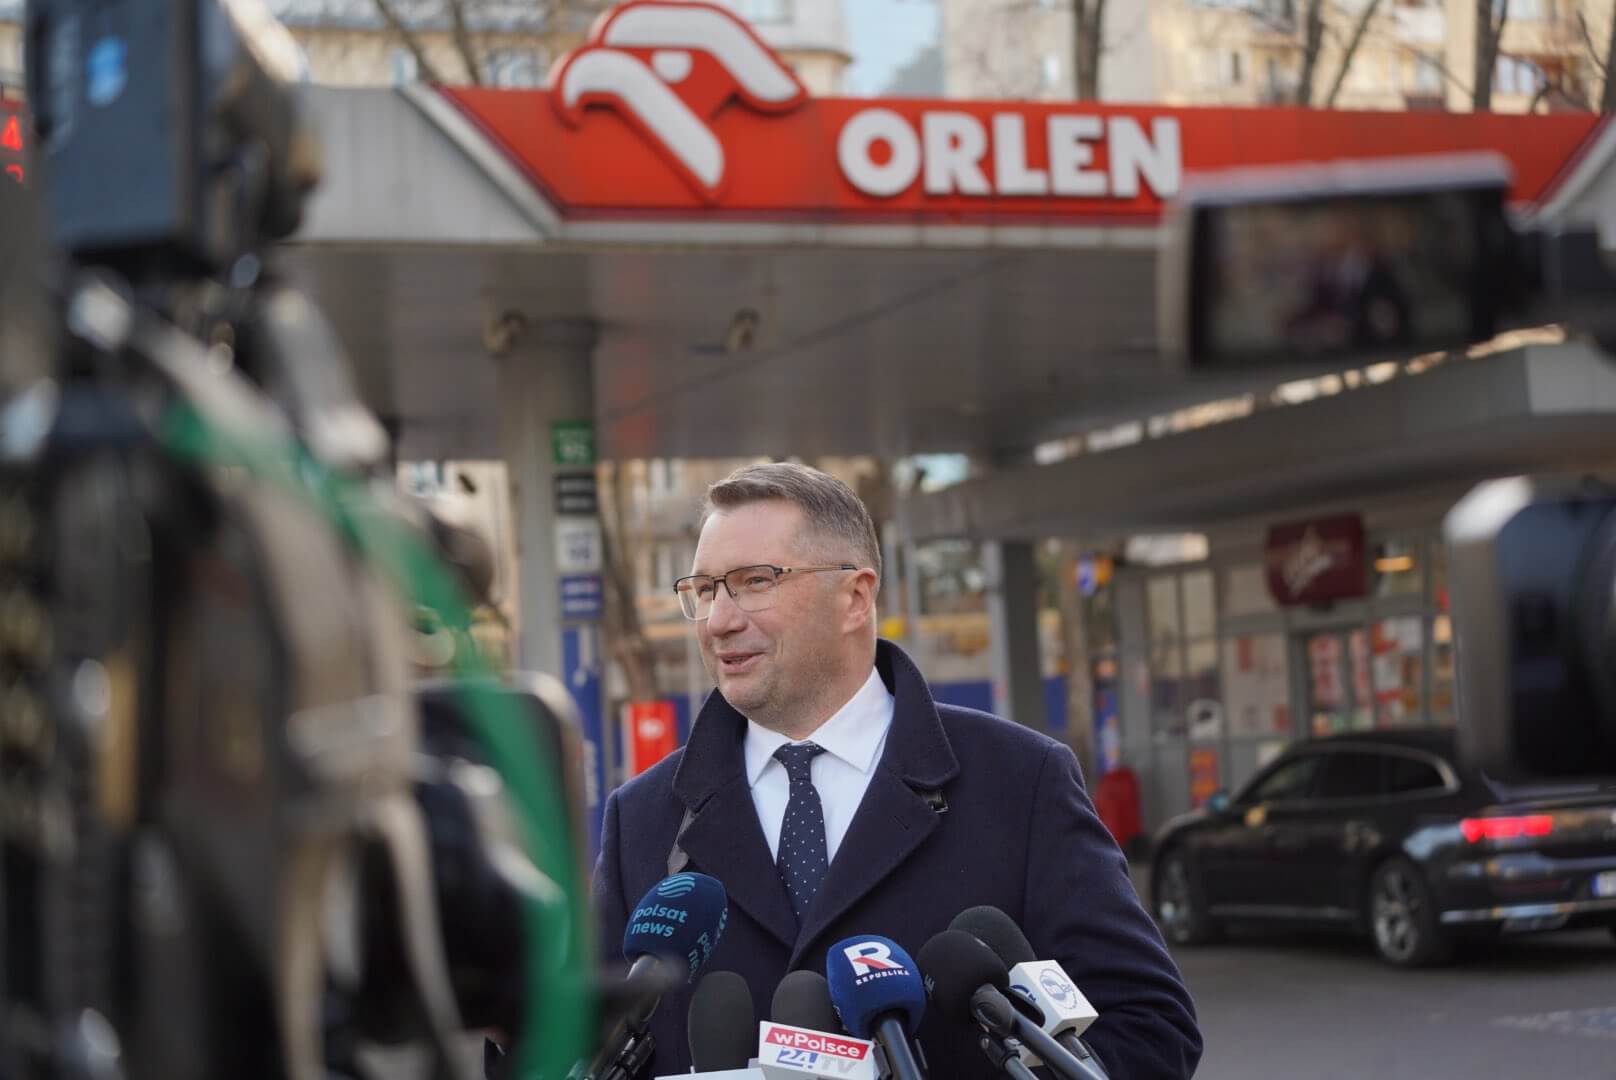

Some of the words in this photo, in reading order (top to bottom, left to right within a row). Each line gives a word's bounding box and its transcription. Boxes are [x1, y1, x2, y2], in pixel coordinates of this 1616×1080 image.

[837, 108, 1183, 199] ORLEN
[631, 903, 688, 923] polsat
[631, 921, 675, 938] news
[855, 969, 911, 987] REPUBLIKA
[773, 1031, 860, 1058] wPolsce
